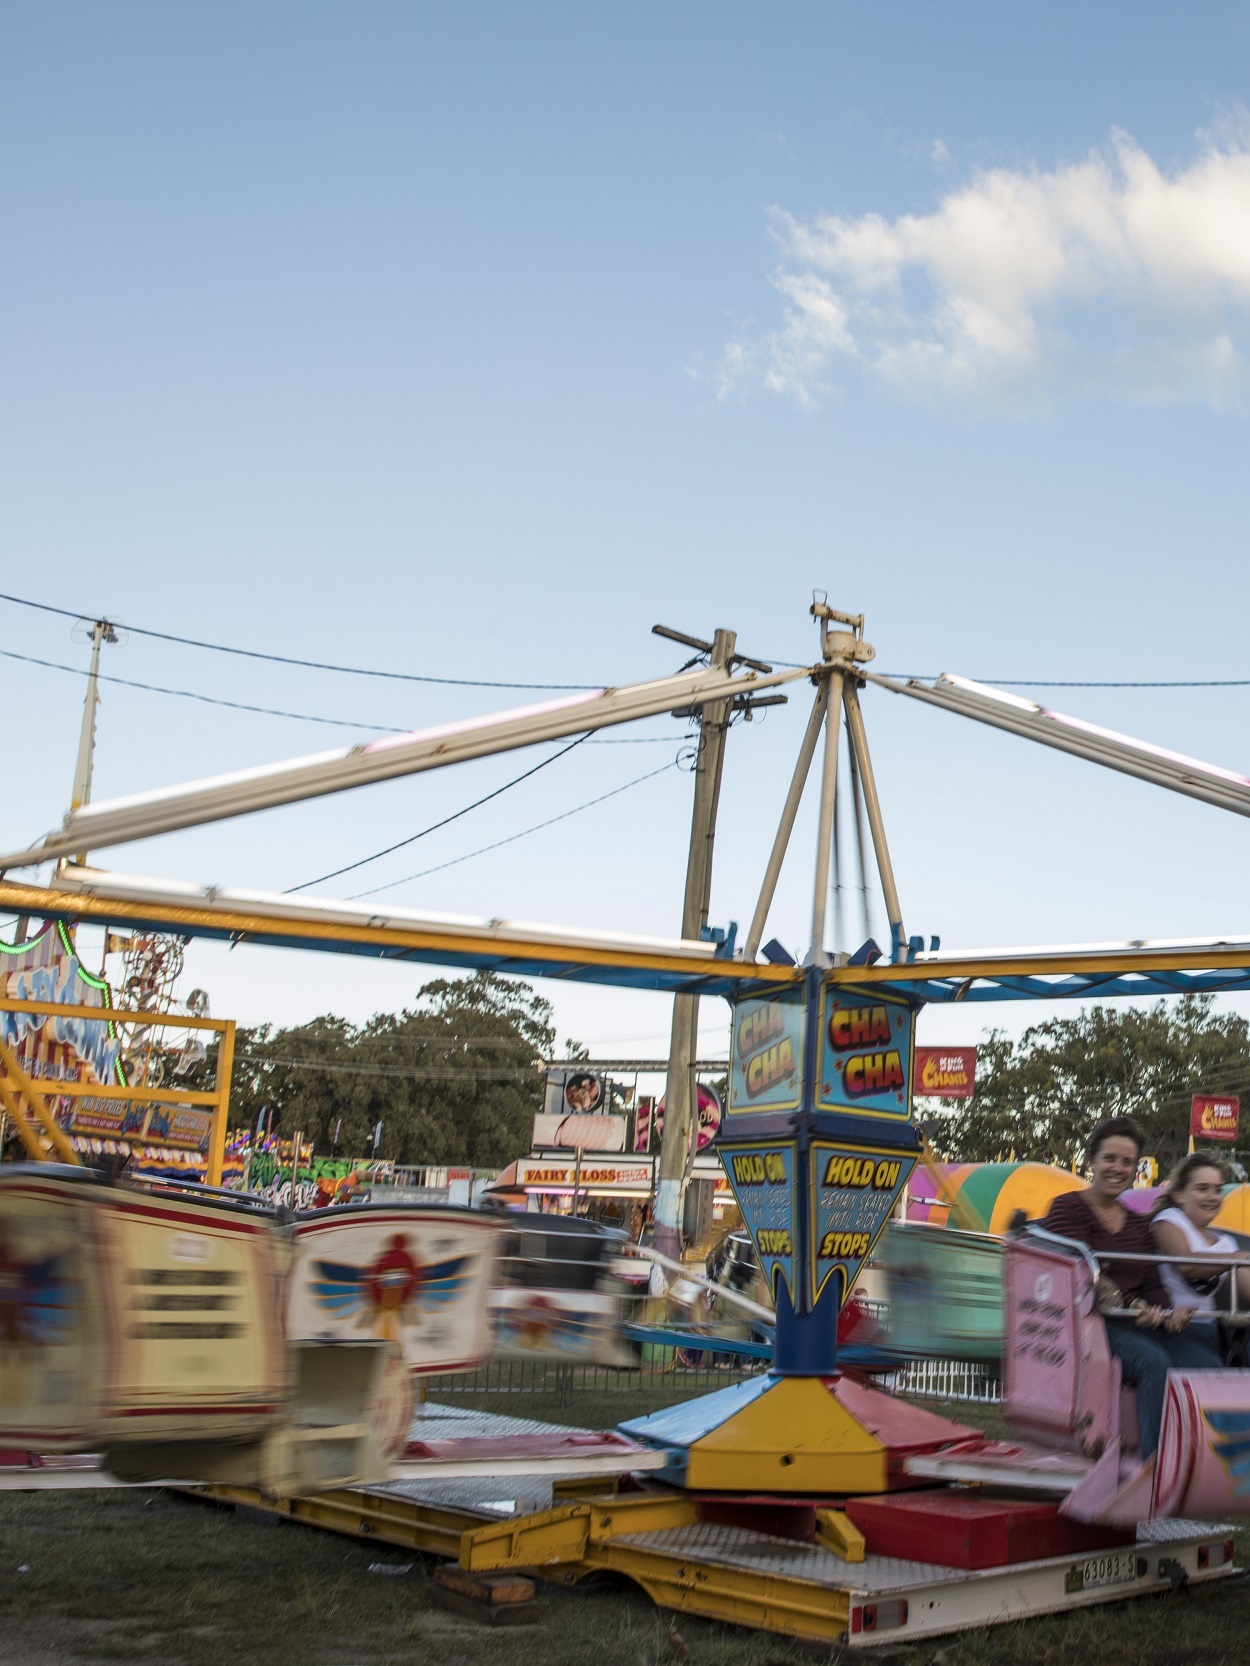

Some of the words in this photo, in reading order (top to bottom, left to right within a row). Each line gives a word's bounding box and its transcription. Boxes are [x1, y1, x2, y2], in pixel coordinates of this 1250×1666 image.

[738, 997, 785, 1058] CHA
[829, 1004, 892, 1053] CHA
[747, 1036, 795, 1099] CHA
[842, 1049, 905, 1100] CHA
[525, 1169, 569, 1184] FAIRY
[732, 1155, 767, 1187] HOLD
[824, 1155, 877, 1189] HOLD
[873, 1160, 902, 1191] ON
[819, 1191, 858, 1211] REMAIN
[858, 1194, 893, 1212] SEATED
[824, 1211, 852, 1230] UNTIL
[854, 1211, 881, 1230] RIDE
[757, 1228, 792, 1258] STOPS
[818, 1232, 871, 1260] STOPS
